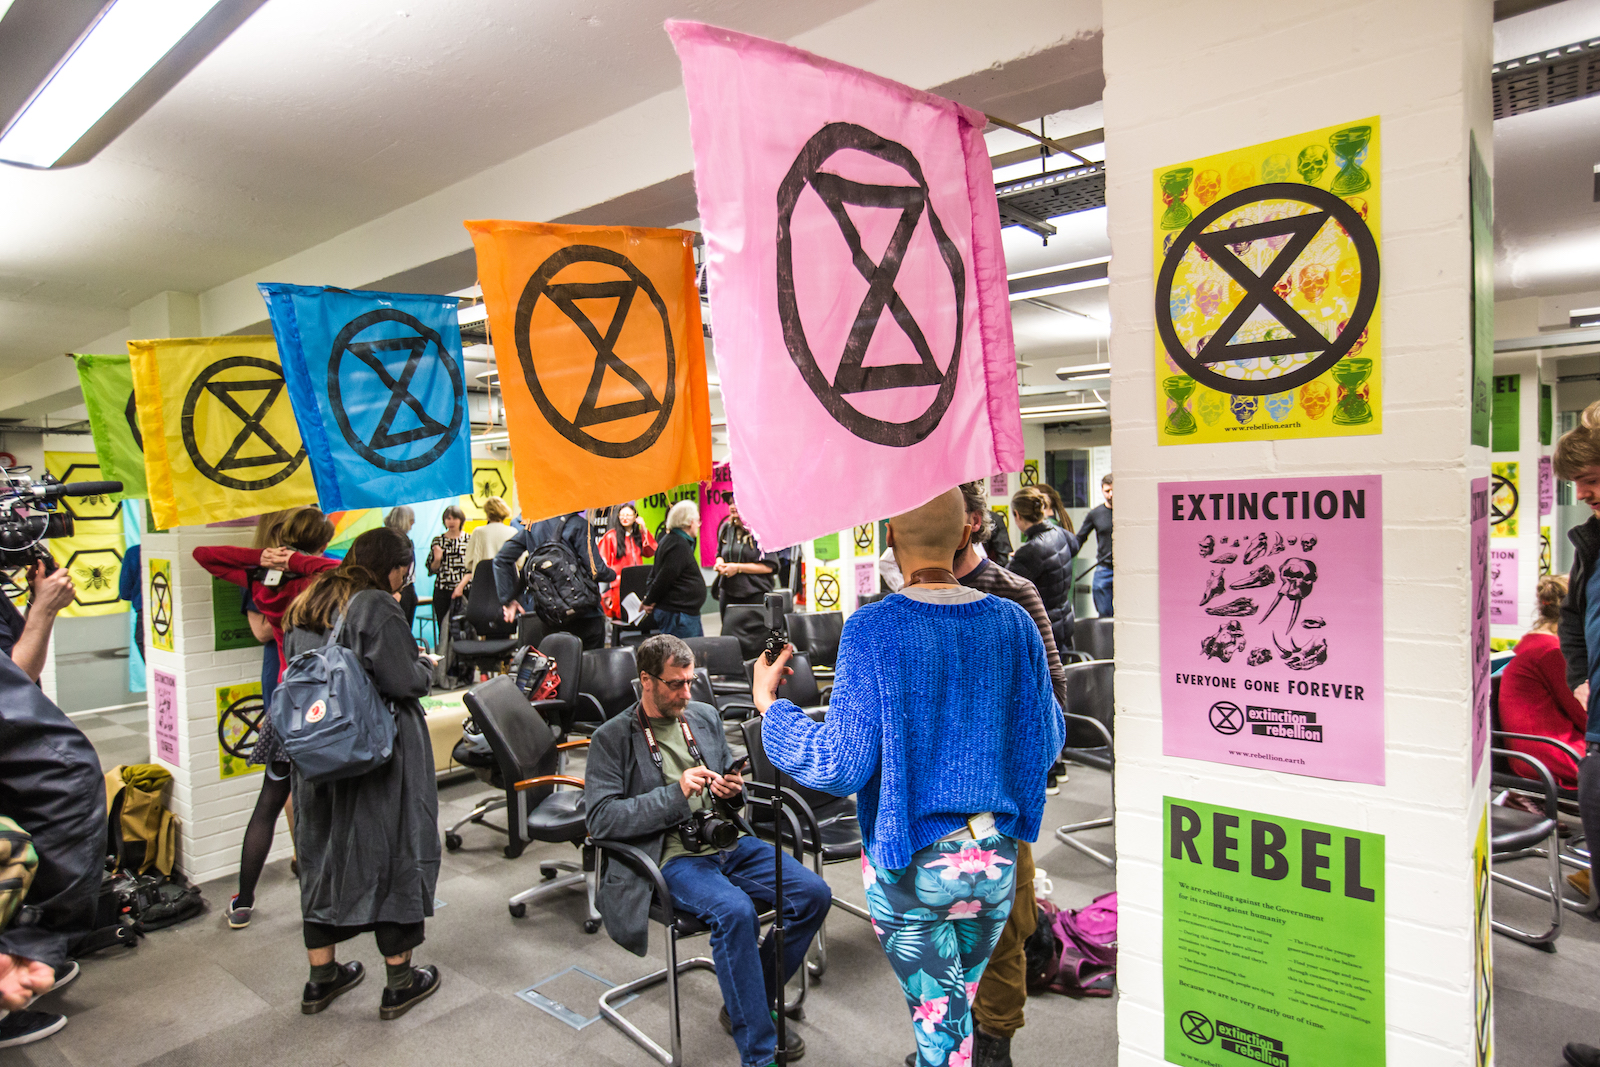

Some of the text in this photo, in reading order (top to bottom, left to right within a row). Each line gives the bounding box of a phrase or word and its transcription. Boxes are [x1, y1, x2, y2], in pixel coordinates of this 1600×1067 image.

[1224, 421, 1301, 432] www.rebellion.earth
[643, 491, 667, 508] FOR
[1172, 489, 1366, 521] EXTINCTION
[1176, 673, 1365, 701] EVERYONE GONE FOREVER
[1248, 707, 1307, 724] extinction
[1265, 723, 1321, 742] rebellion
[1228, 749, 1306, 765] www.rebellion.earth
[1170, 803, 1376, 903] REBEL
[1199, 900, 1222, 909] crimes
[1224, 906, 1248, 915] against
[1250, 910, 1287, 927] humanity
[1203, 889, 1234, 902] rebelling
[1236, 897, 1260, 906] against
[1262, 901, 1274, 910] the
[1276, 904, 1324, 922] Government
[1179, 979, 1204, 992] Because
[1240, 1000, 1255, 1010] very
[1258, 1006, 1280, 1018] nearly
[1306, 1018, 1326, 1030] time.
[1218, 1024, 1274, 1051] extinction
[1235, 1043, 1288, 1067] rebellion
